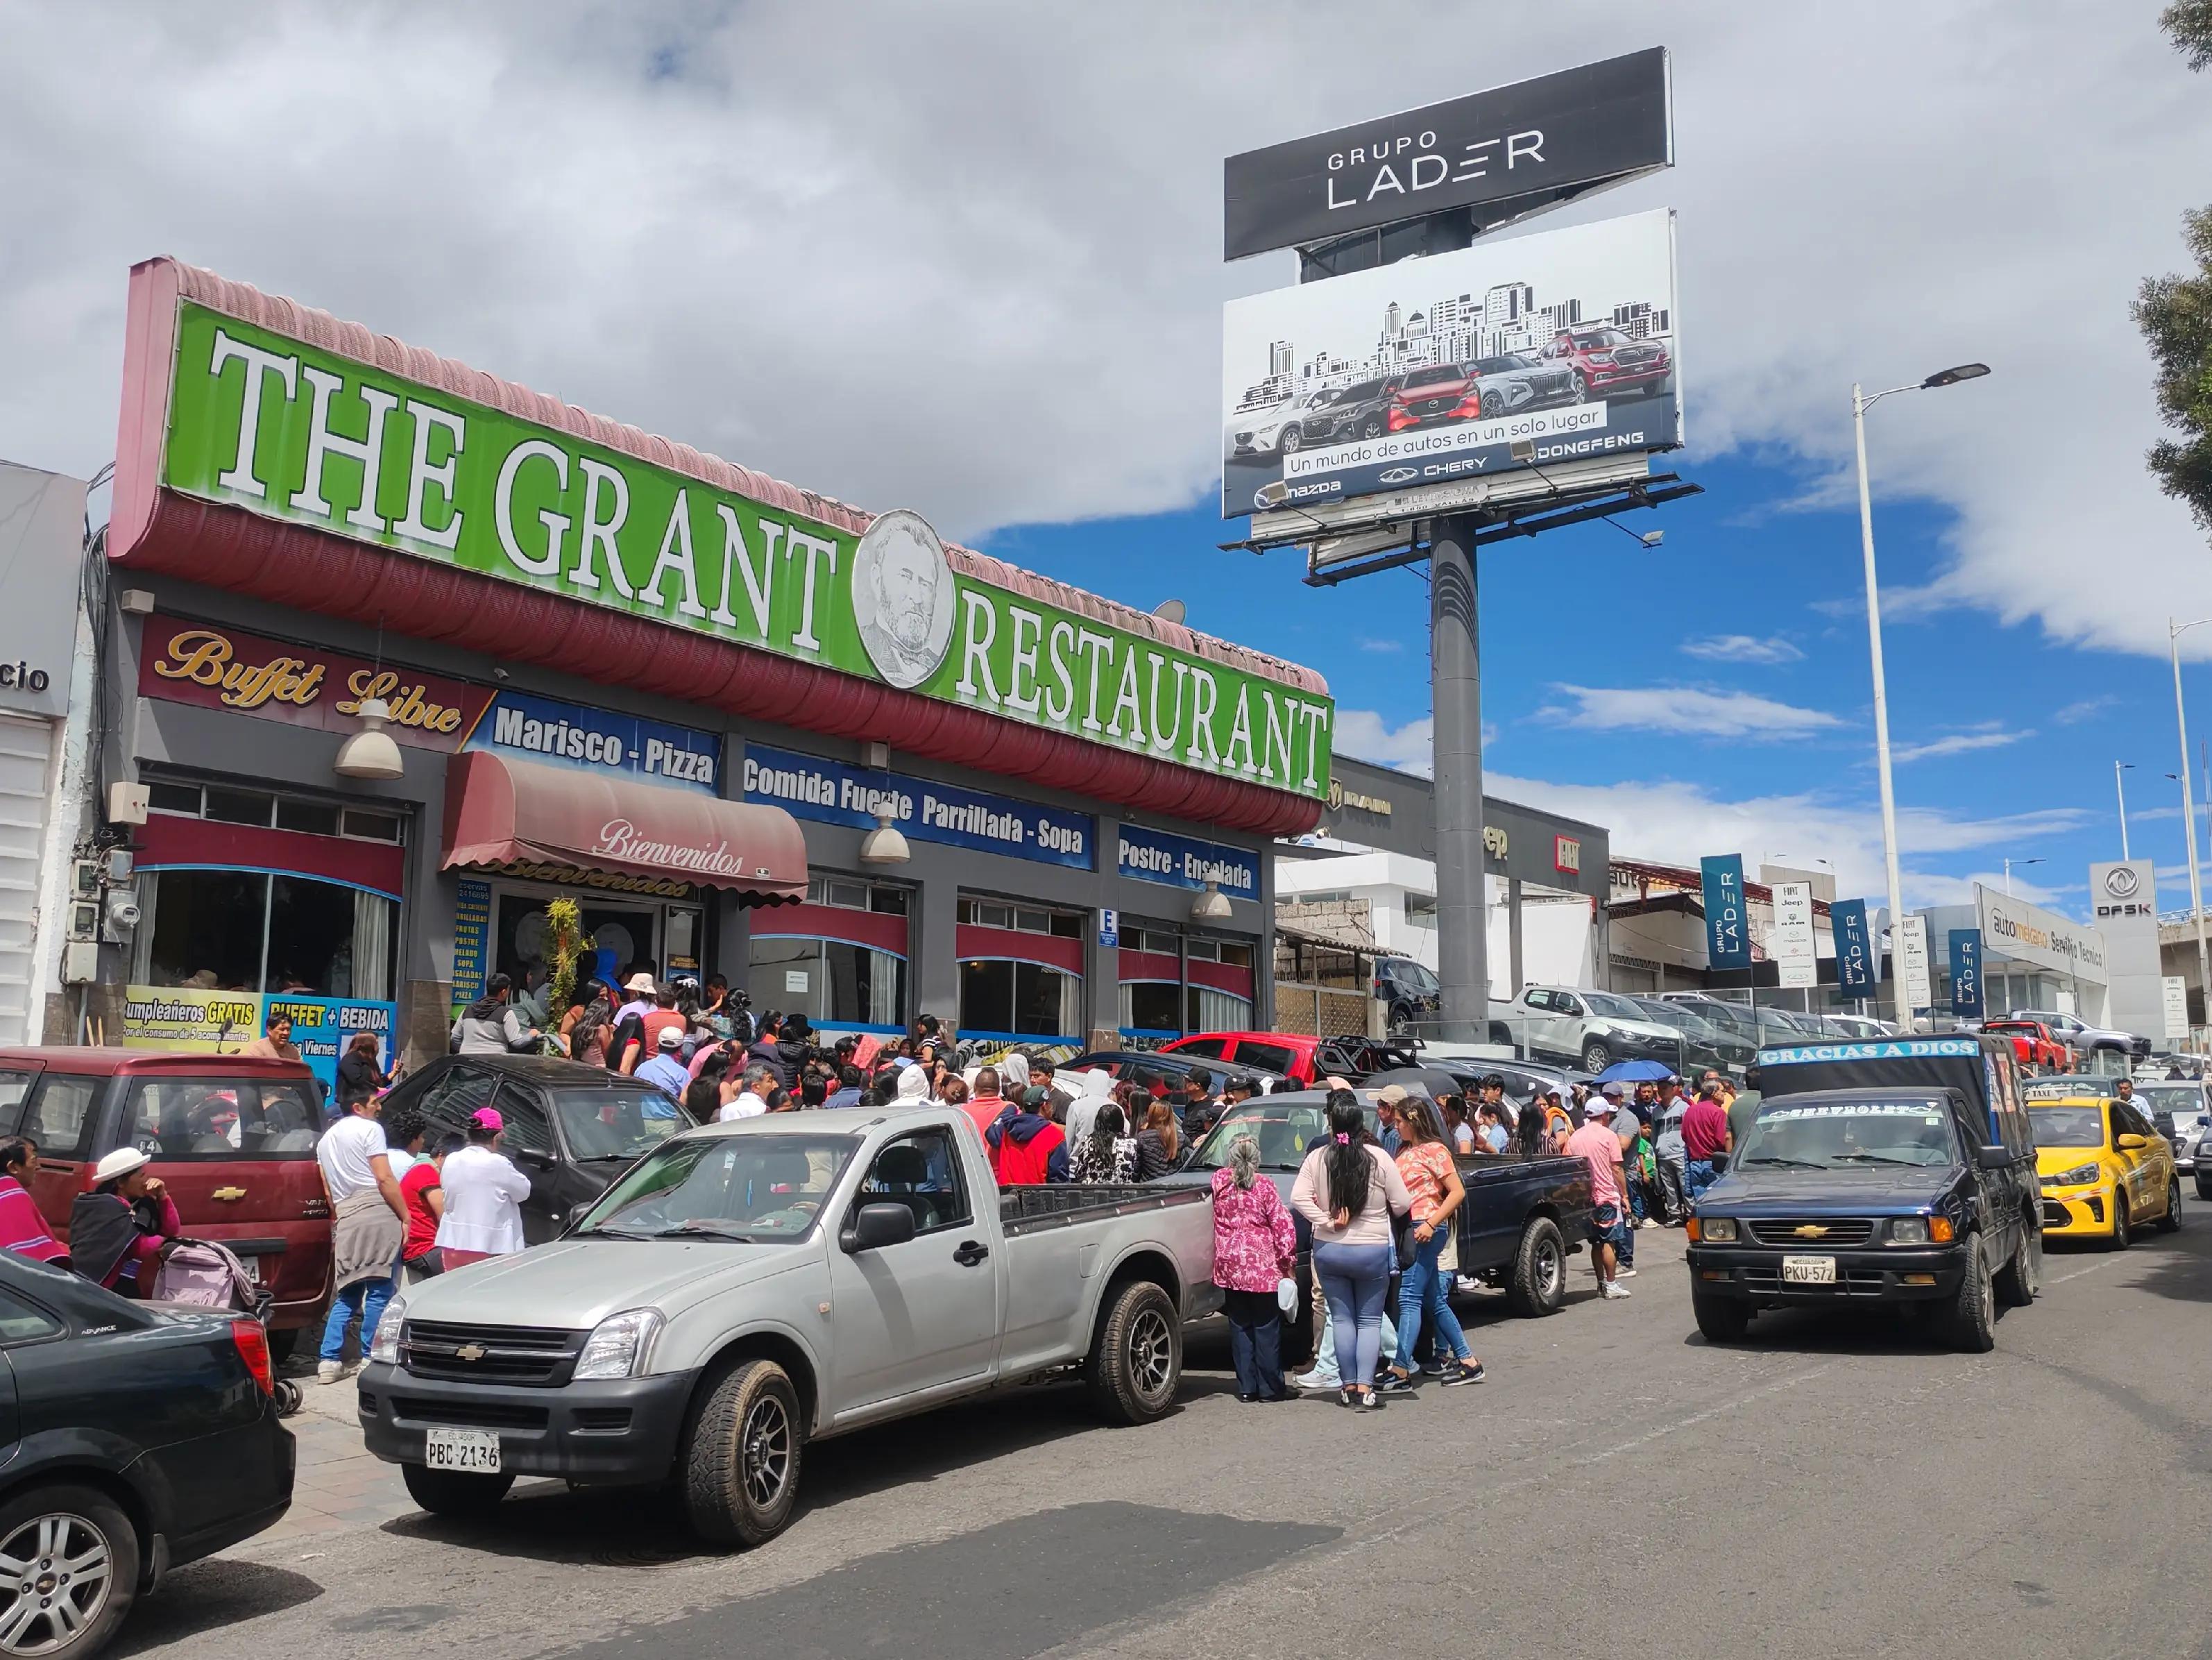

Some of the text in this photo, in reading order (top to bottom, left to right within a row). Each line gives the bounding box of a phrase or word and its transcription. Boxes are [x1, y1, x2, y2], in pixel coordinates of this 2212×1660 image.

[1328, 130, 1436, 171] GRUPO
[1289, 409, 1599, 473] Un mundo de autos en un solo lugar
[1537, 432, 1644, 459] DONGFENG
[1424, 457, 1488, 477] CHERY
[209, 328, 837, 653] THE GRANT
[0, 660, 49, 692] cio
[155, 630, 461, 732] Buffet Libre
[955, 588, 1327, 790] RESTAURANT
[493, 706, 622, 765] Marisco
[647, 739, 714, 784] Pizza
[743, 758, 835, 807] Comida
[922, 795, 1025, 844] Parrillada
[1037, 818, 1084, 855] Sopa
[1344, 790, 1391, 815] RAM
[591, 819, 743, 875] Bienvenidos
[1118, 837, 1172, 875] Postre
[1783, 886, 1798, 896] FIAT
[1105, 911, 1112, 931] E
[2097, 903, 2152, 916] DFSK
[454, 937, 479, 947] POSTRE
[1715, 920, 1724, 953] GRUPO
[457, 959, 474, 968] SOPA
[1844, 956, 1853, 985] GRUPO
[454, 991, 472, 999] PIZZA
[125, 997, 255, 1026] umpleañeros GRATIS
[339, 1007, 389, 1031] BEBIDA
[135, 1026, 144, 1038] el
[144, 1028, 178, 1040] consumo
[179, 1026, 189, 1040] de
[191, 1028, 196, 1040] 5
[197, 1031, 250, 1044] acompñantes
[305, 1040, 338, 1056] Viernes
[1761, 1041, 1977, 1064] GRACIAS A DIOS
[1790, 1105, 1910, 1118] CHEVROLET
[81, 1324, 117, 1335] ADVANCE
[448, 1431, 476, 1441] ECUADOR
[429, 1443, 497, 1467] PBC-2136
